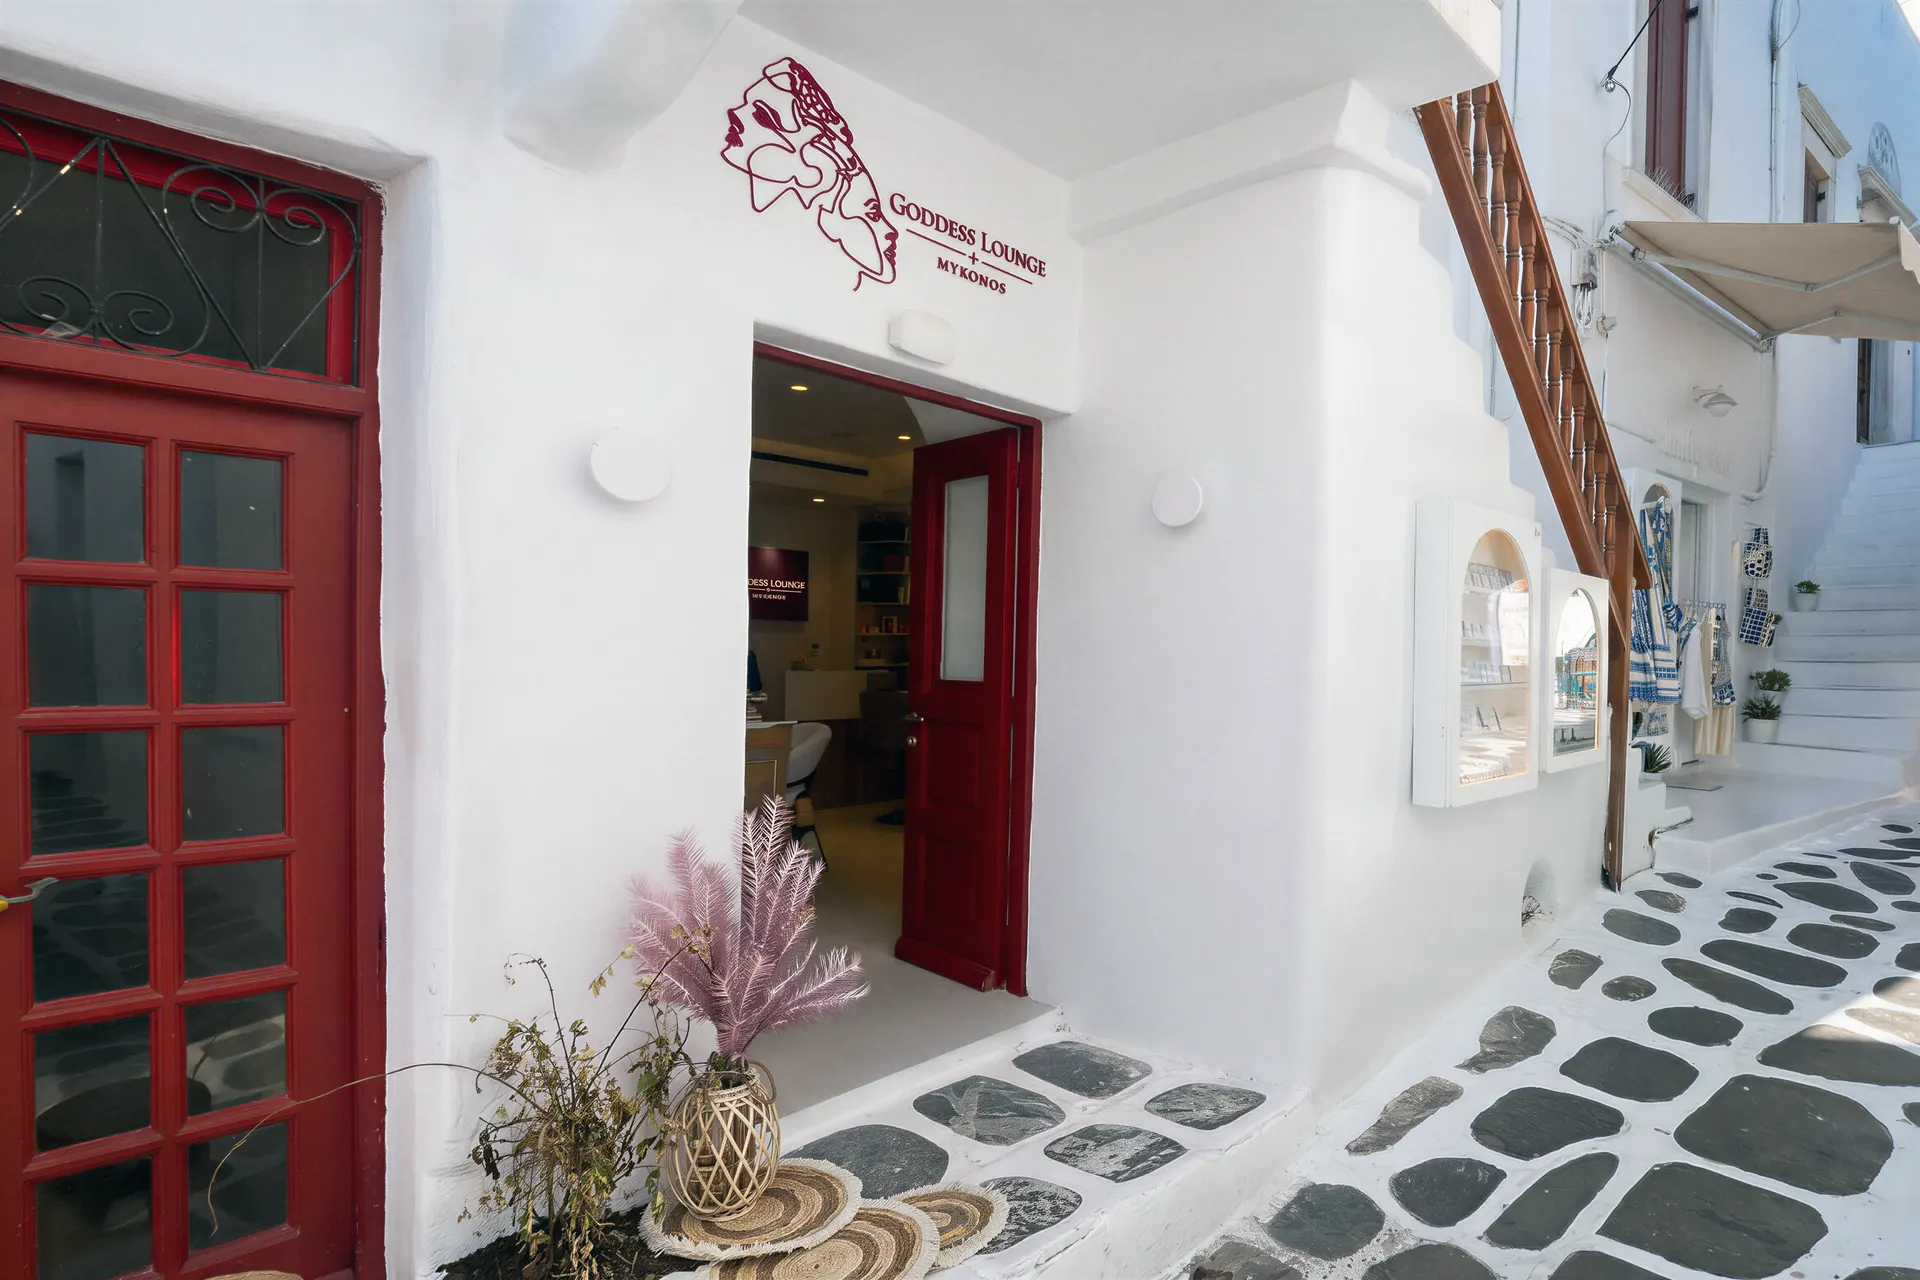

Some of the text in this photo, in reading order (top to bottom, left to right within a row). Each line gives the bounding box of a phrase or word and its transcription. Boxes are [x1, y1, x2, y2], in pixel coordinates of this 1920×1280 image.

[889, 192, 1047, 278] GODDESS LOUNGE
[937, 256, 1006, 295] MYKONOS
[770, 579, 806, 589] LOUNGE
